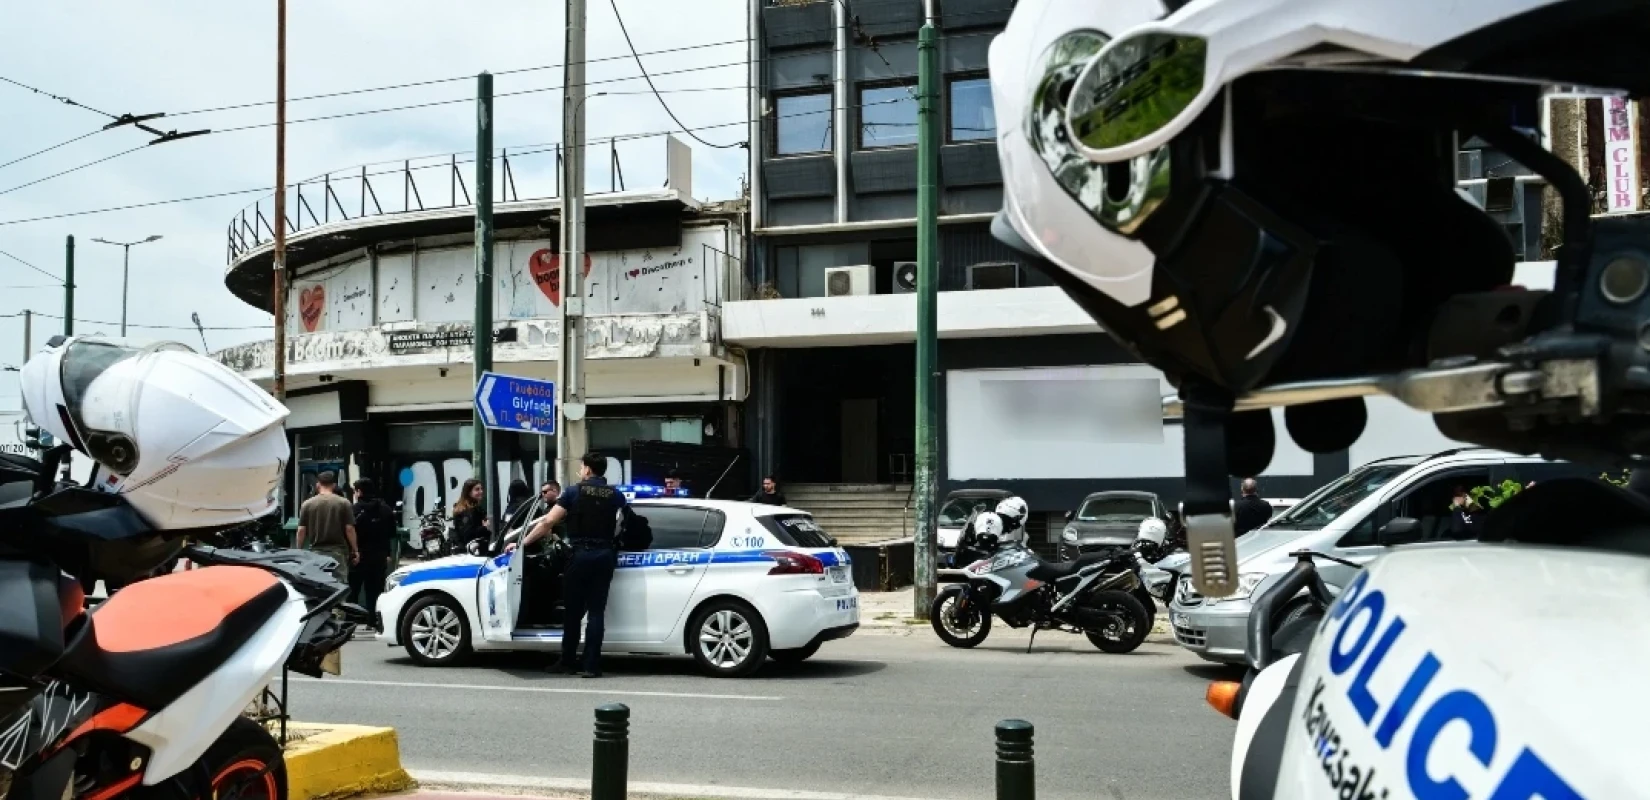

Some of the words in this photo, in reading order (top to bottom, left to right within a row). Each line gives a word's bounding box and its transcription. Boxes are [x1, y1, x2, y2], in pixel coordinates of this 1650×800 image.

[1613, 147, 1631, 208] CLUB
[536, 268, 560, 285] boo
[509, 381, 551, 397] Γλυφάδα
[512, 396, 551, 416] Glyfada
[745, 536, 765, 548] 100
[654, 551, 700, 564] ΔΡΑΣΗ
[1302, 676, 1389, 800] Kawasak
